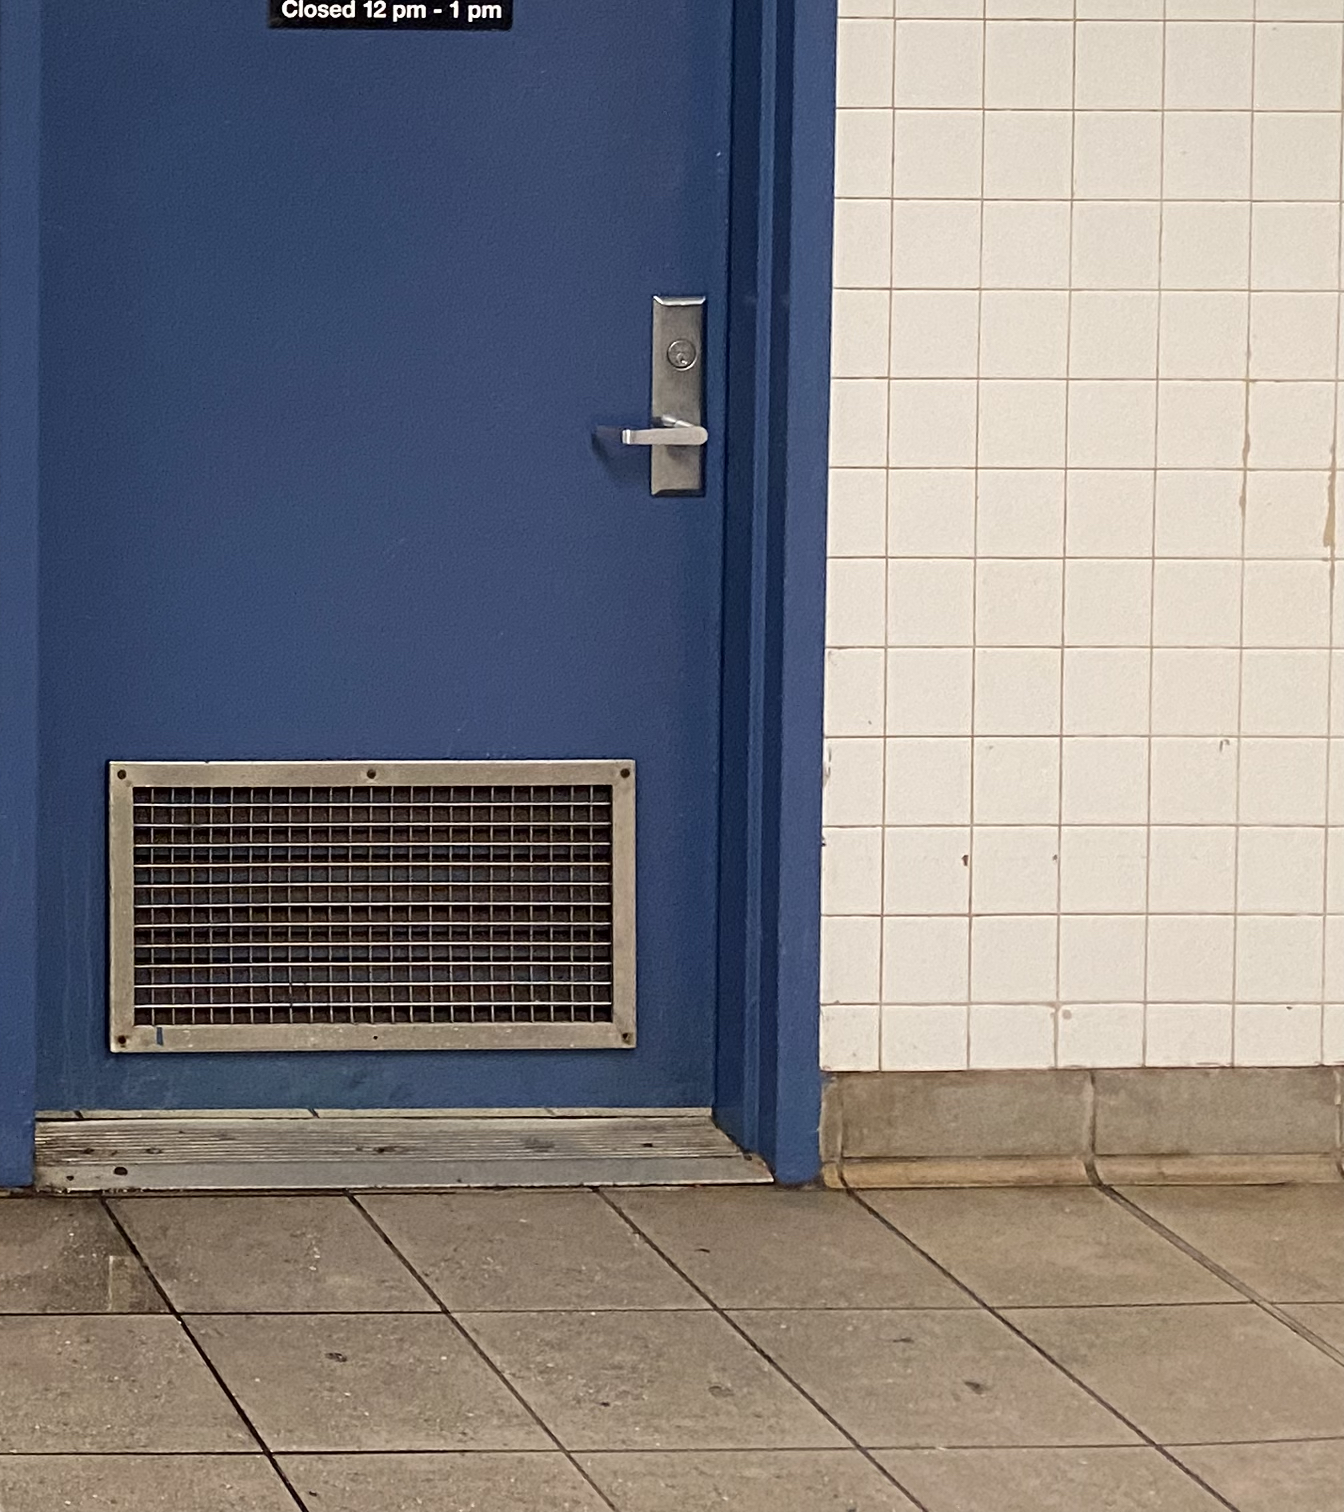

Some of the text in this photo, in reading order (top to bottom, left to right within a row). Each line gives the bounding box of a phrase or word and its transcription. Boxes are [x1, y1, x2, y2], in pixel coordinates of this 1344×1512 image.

[281, 0, 356, 19] Closed
[363, 0, 386, 19] 12
[392, 3, 427, 22] pm
[450, 0, 460, 18] 1
[468, 3, 502, 22] pm
